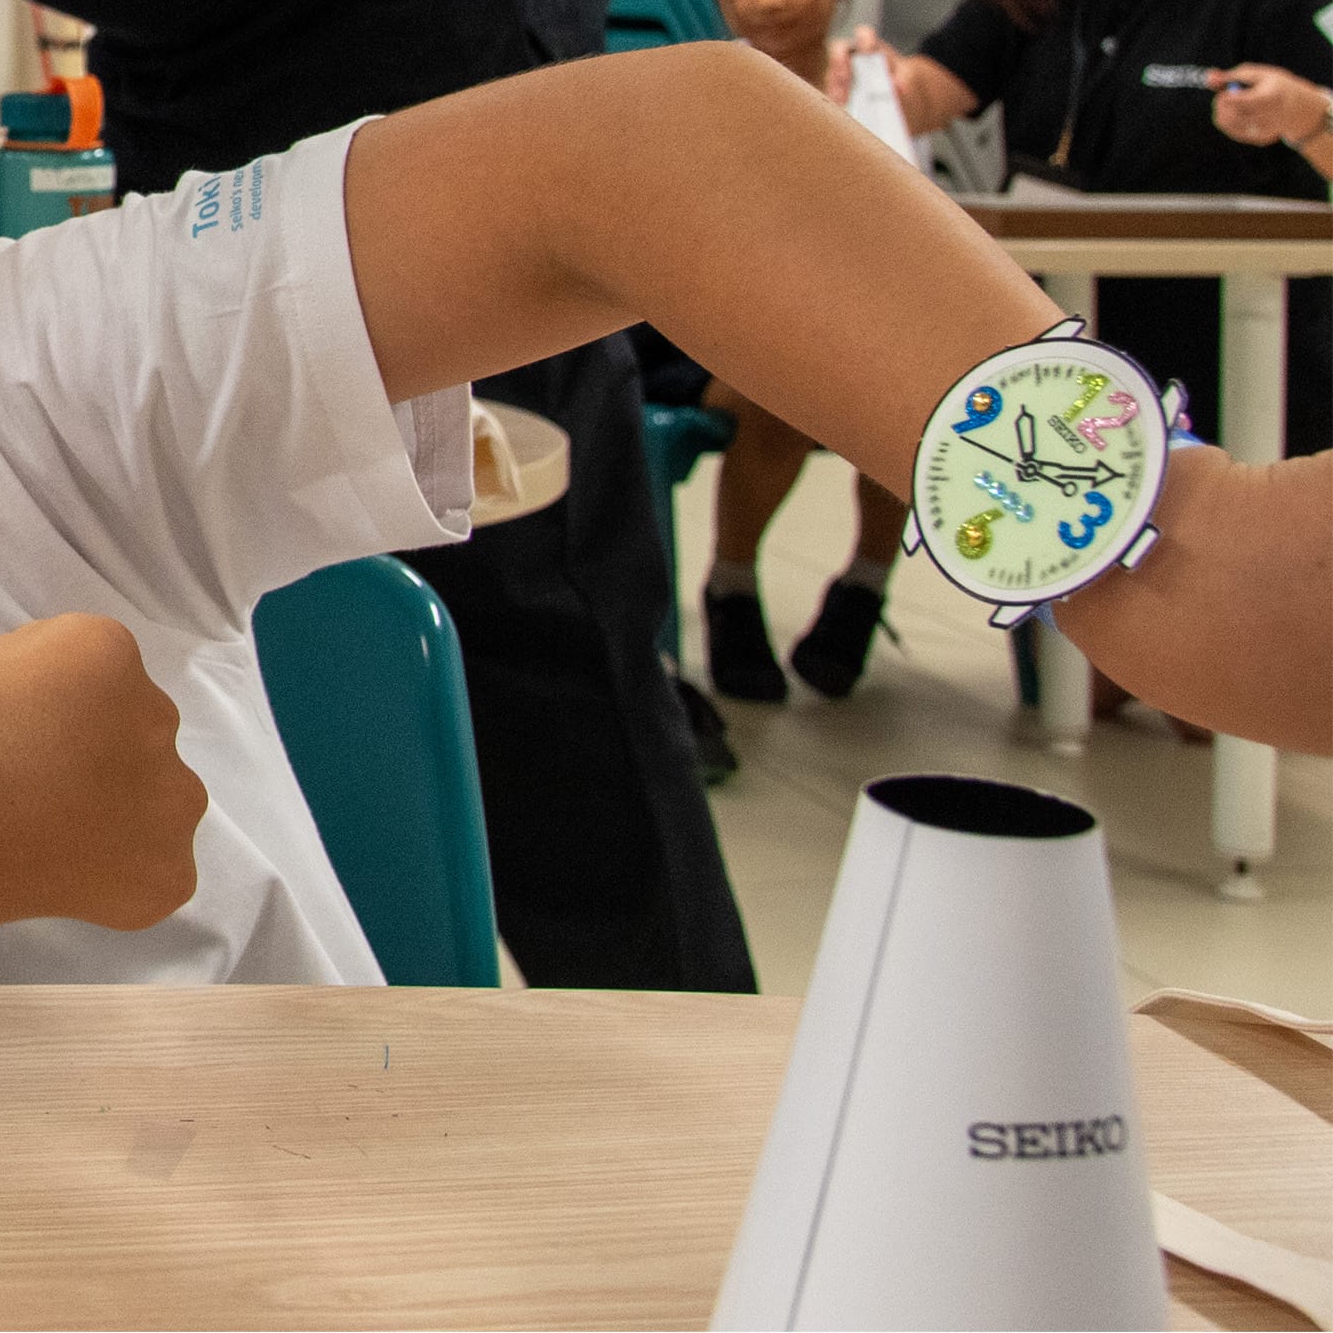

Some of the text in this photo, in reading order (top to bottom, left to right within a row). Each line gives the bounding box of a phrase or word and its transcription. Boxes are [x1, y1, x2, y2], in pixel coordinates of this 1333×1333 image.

[1046, 414, 1087, 454] SEIKO
[1061, 372, 1140, 451] 12
[1057, 491, 1114, 550] 3
[967, 1112, 1130, 1161] SEIKO
